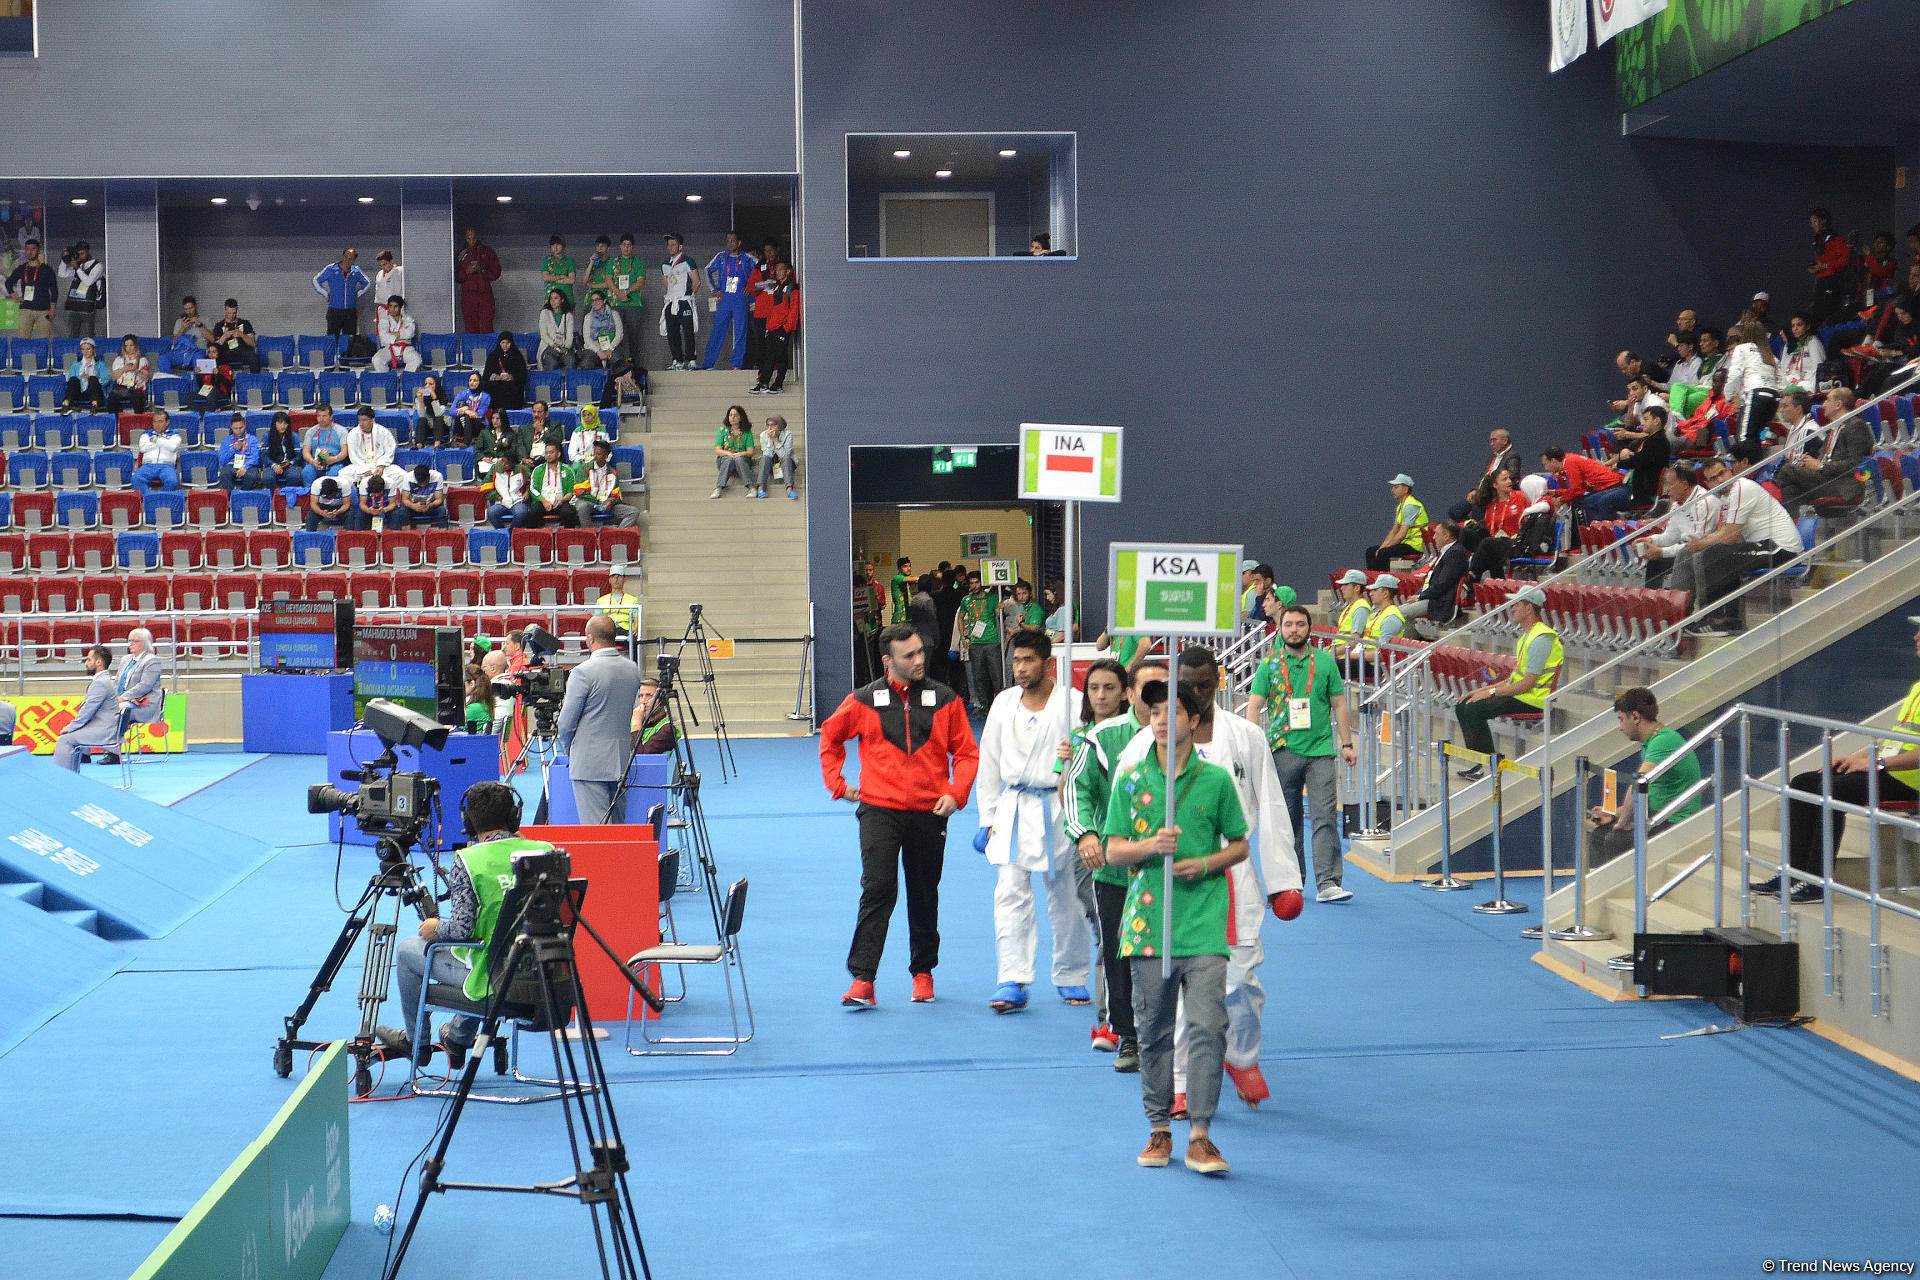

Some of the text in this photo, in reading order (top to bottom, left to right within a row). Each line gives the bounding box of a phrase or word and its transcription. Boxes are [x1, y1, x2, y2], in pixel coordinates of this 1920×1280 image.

[1054, 435, 1086, 452] INA
[1152, 556, 1201, 576] KSA
[313, 603, 334, 614] ROMAN
[361, 628, 418, 641] MAHMOUD SAJAN
[390, 643, 398, 661] 0
[390, 663, 398, 681] 0
[398, 797, 405, 809] 3
